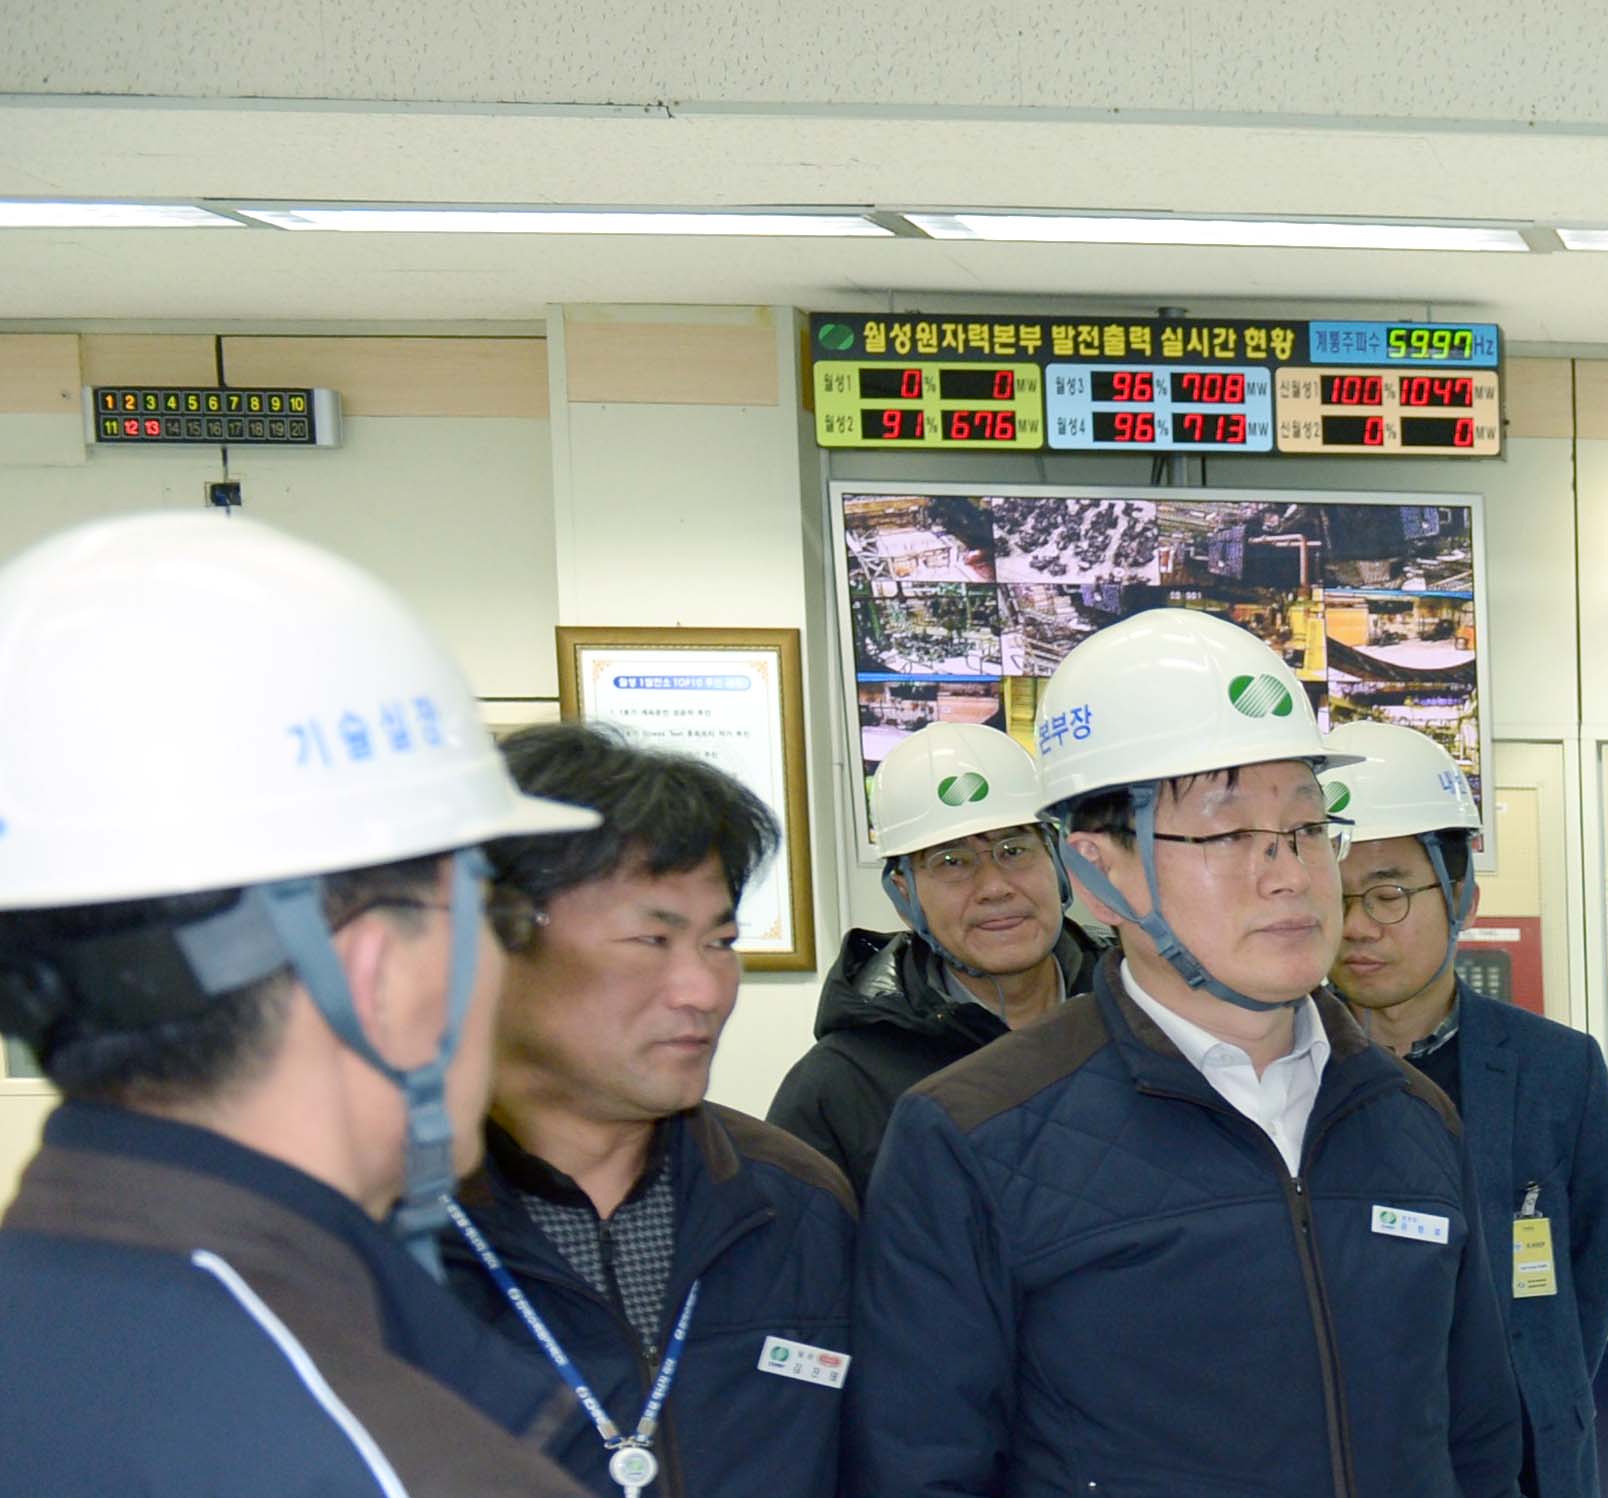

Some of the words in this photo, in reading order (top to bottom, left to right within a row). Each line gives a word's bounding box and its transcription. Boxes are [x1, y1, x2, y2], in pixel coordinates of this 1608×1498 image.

[863, 321, 1042, 354] 월성원자력본부
[1051, 324, 1151, 356] 발전출력
[1161, 327, 1237, 358] 실시간
[1244, 327, 1295, 360] 현황
[1474, 335, 1494, 355] Hz
[901, 369, 921, 398] 0
[924, 377, 936, 392] %
[993, 370, 1013, 399] 0
[1016, 378, 1037, 392] MW
[1112, 371, 1153, 401] 96
[1156, 379, 1167, 395] %
[1182, 373, 1244, 403] 708
[1247, 382, 1267, 395] MW
[1331, 376, 1382, 405] 100
[1384, 383, 1396, 398] %
[1400, 377, 1472, 406] 1047
[1475, 385, 1495, 399] MW
[105, 397, 113, 409] 1
[125, 397, 134, 409] 2
[146, 397, 156, 410] 3
[167, 397, 177, 410] 4
[188, 397, 198, 410] 5
[208, 397, 218, 410] 6
[229, 397, 238, 410] 7
[250, 398, 260, 410] 8
[272, 398, 280, 411] 9
[290, 398, 304, 411] 10
[104, 421, 118, 434] 11
[124, 421, 139, 434] 12
[145, 421, 159, 434] 13
[166, 421, 179, 434] 14
[187, 421, 200, 435] 15
[208, 421, 221, 435] 16
[228, 422, 241, 435] 17
[249, 422, 263, 435] 18
[270, 422, 284, 435] 19
[291, 422, 304, 435] 20
[882, 410, 923, 439] 91
[926, 418, 938, 432] %
[951, 411, 1015, 440] 676
[1017, 420, 1039, 432] MW
[1114, 413, 1154, 442] 96
[1157, 421, 1169, 436] %
[1183, 414, 1245, 443] 713
[1248, 423, 1268, 436] MW
[1364, 417, 1383, 445] 0
[1385, 425, 1397, 438] %
[1454, 418, 1473, 446] 0
[1475, 426, 1496, 439] MW
